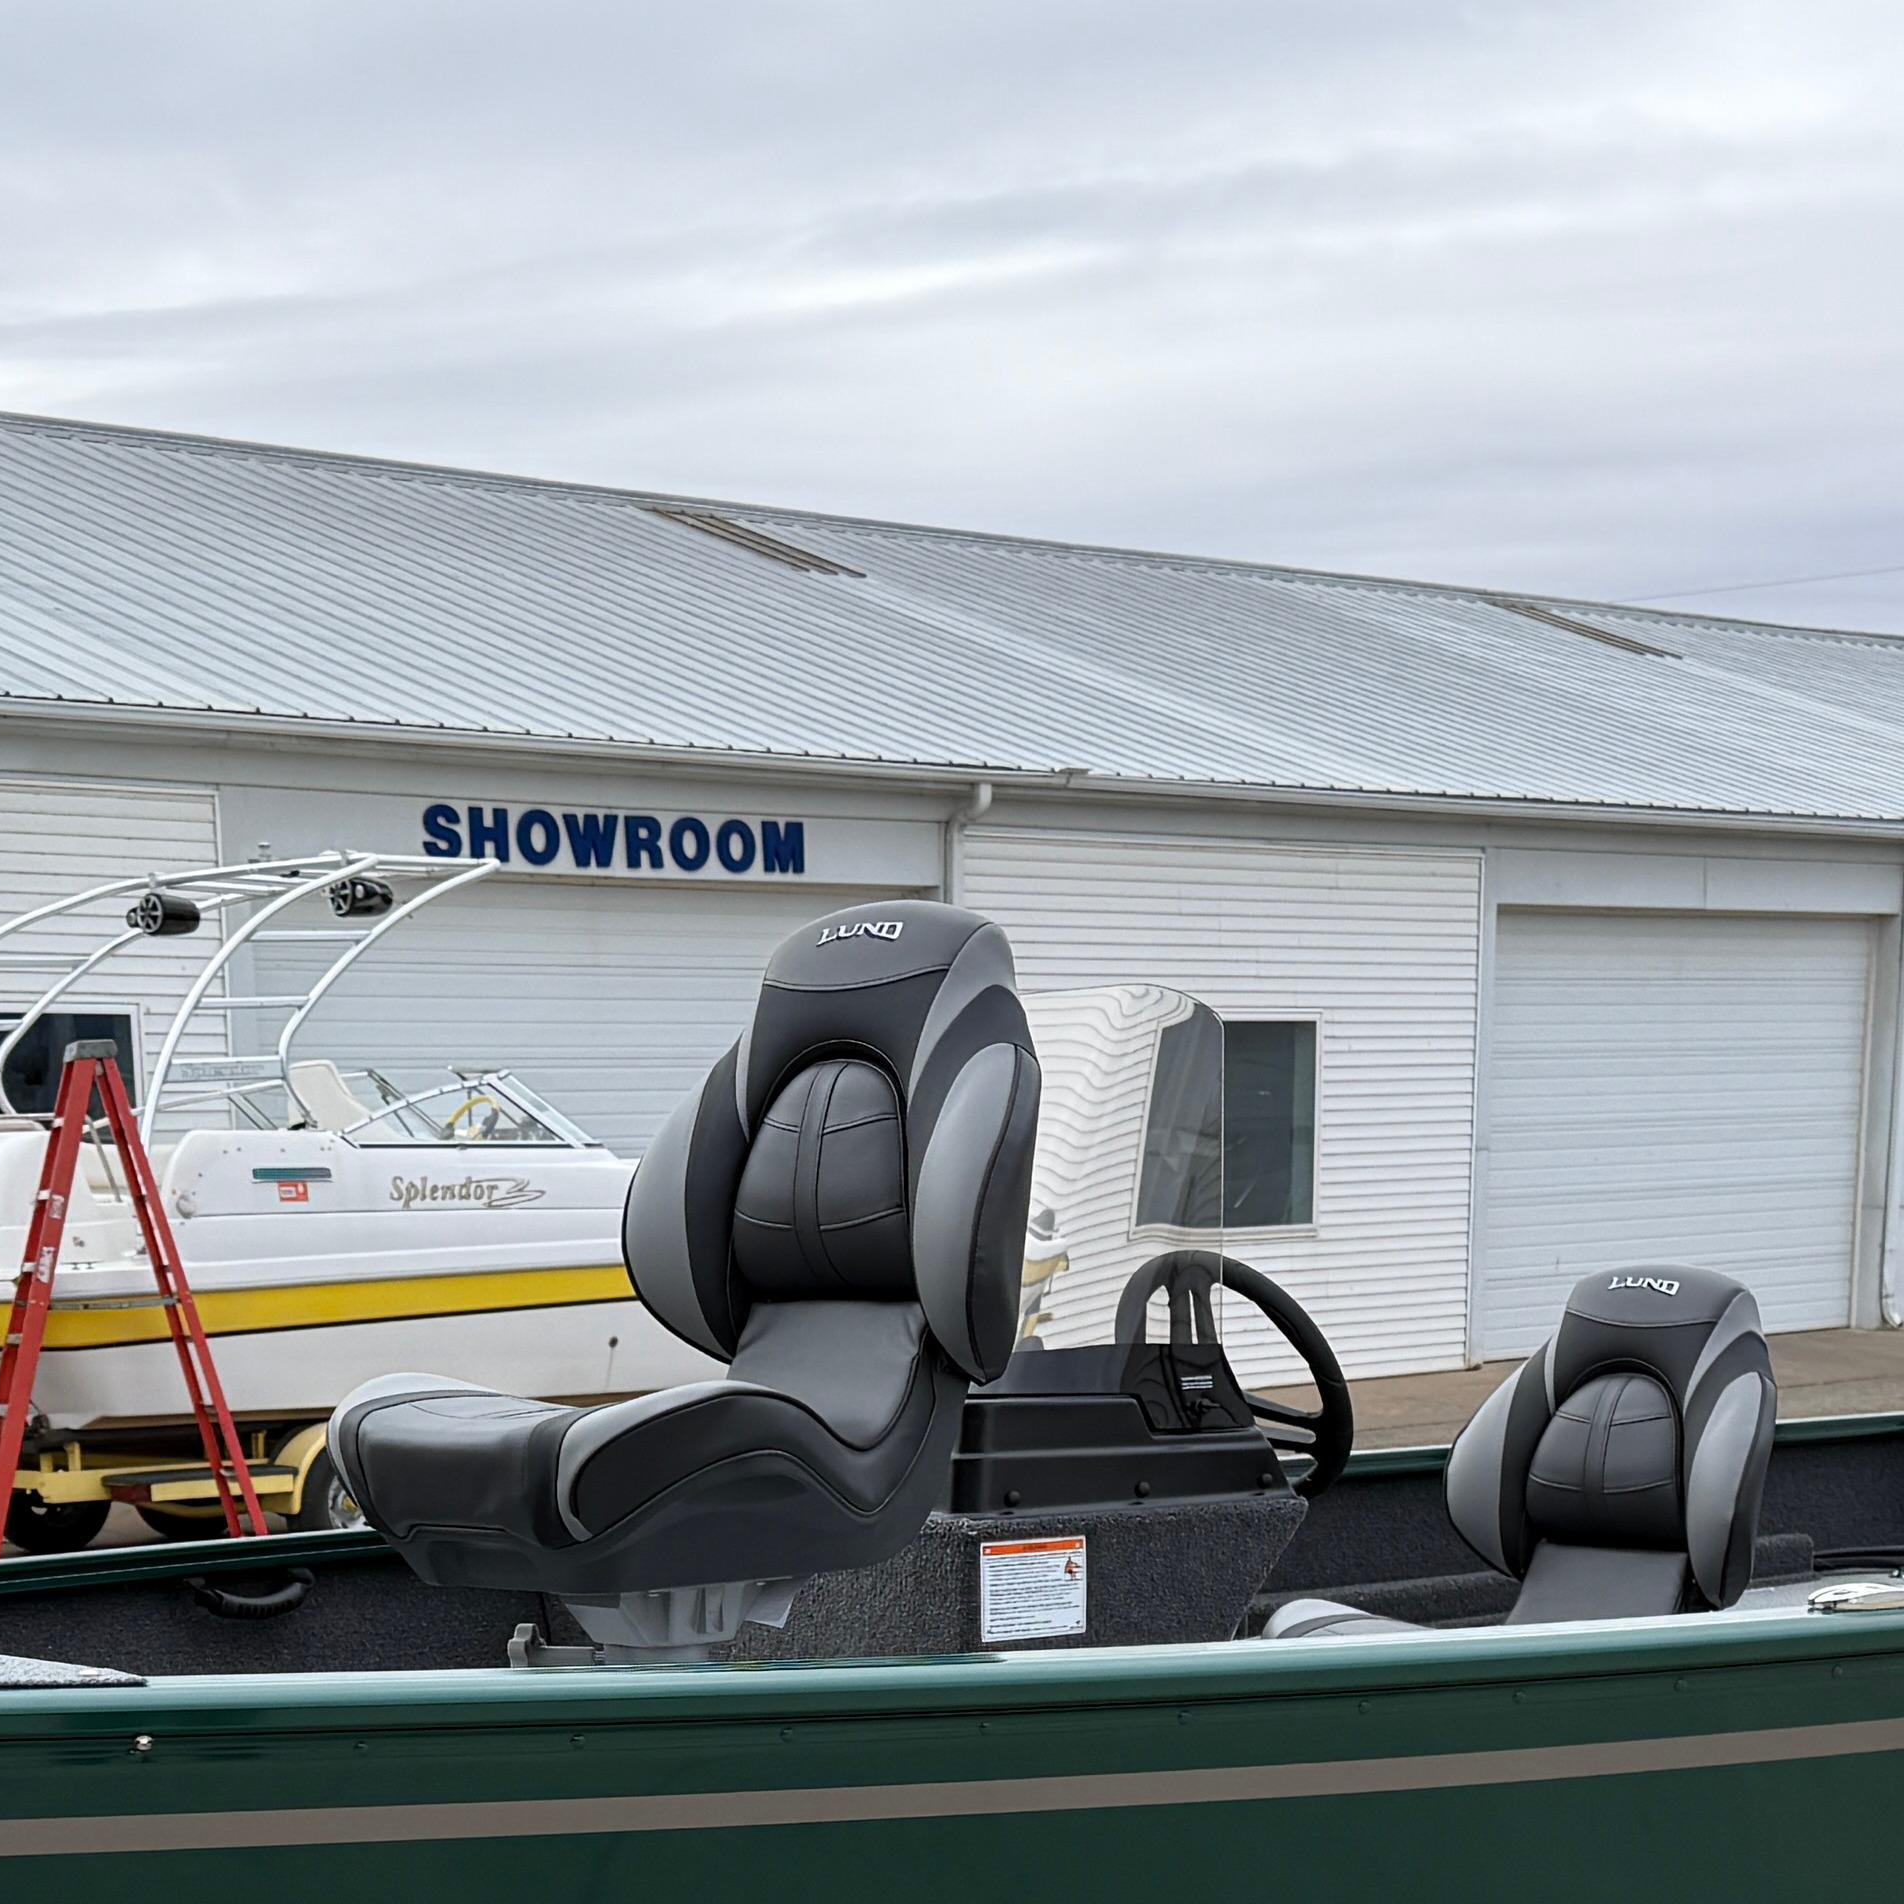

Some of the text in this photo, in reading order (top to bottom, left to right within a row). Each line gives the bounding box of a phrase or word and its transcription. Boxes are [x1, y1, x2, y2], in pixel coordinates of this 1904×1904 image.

[422, 804, 805, 875] SHOWROOM
[816, 921, 904, 947] LUND
[389, 1175, 499, 1208] Splendor
[1608, 1276, 1680, 1296] LUND
